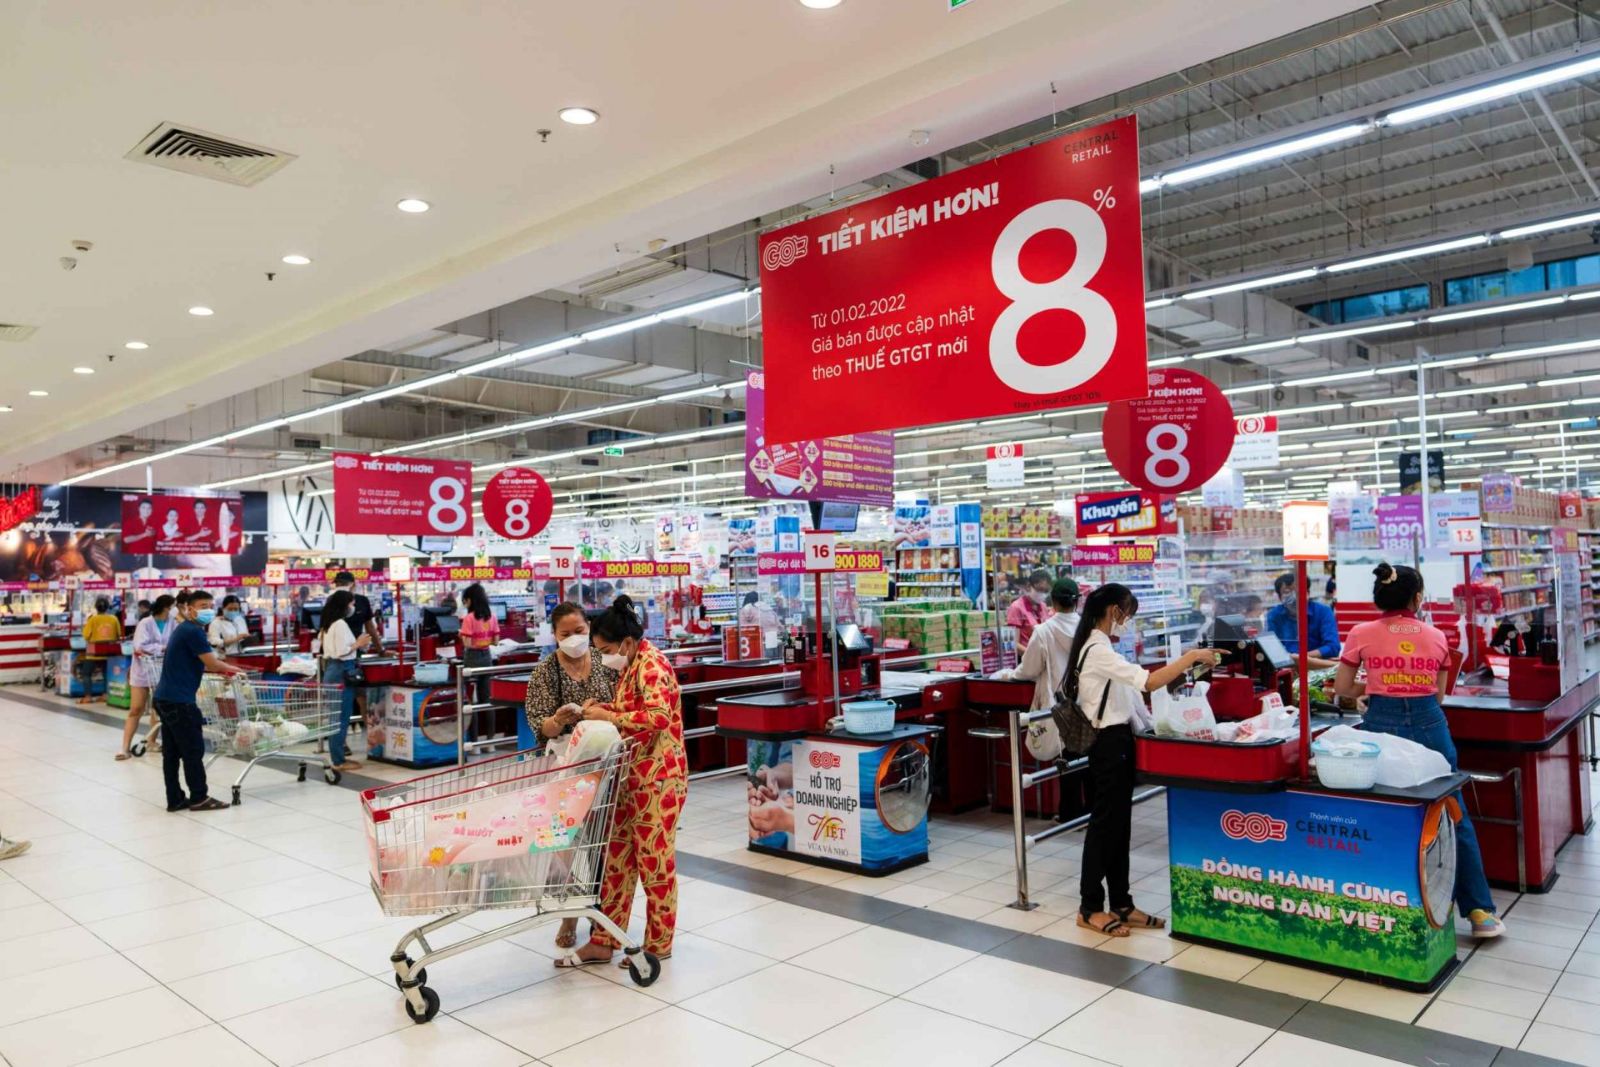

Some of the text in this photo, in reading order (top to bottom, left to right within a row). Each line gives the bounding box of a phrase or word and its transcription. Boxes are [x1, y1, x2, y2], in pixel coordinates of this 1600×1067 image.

[1064, 130, 1119, 154] CENTRAL
[1071, 145, 1112, 164] RETAIL
[818, 182, 999, 255] TIẾT KIỆM HƠN!
[811, 293, 906, 330] Từ 01.02.2022
[811, 304, 975, 354] Giá bán được cập nhật
[812, 336, 968, 381] theo THUẾ GTGT mới
[1082, 498, 1138, 521] Khuyến
[1301, 521, 1322, 540] 14
[1380, 522, 1422, 538] 1900
[1456, 529, 1475, 543] 13
[812, 544, 830, 558] 16
[1118, 547, 1135, 561] 1900
[1137, 547, 1153, 561] 1880
[555, 558, 570, 569] 18
[606, 563, 629, 575] 1900
[632, 562, 654, 575] 1880
[836, 554, 880, 568] 900 1880
[268, 569, 281, 578] 22
[450, 567, 472, 578] 1900
[474, 567, 494, 578] 1880
[1368, 656, 1406, 669] 1900
[824, 776, 842, 794] TRỢ
[796, 790, 858, 814] DOANH NGHIỆP
[1296, 820, 1373, 841] CENTRAL
[1307, 834, 1361, 855] RETAIL
[1202, 856, 1409, 907] ĐỒNG HÀNH CÙNG
[1213, 885, 1275, 911] NÔNG
[1339, 907, 1397, 934] VIỆT
